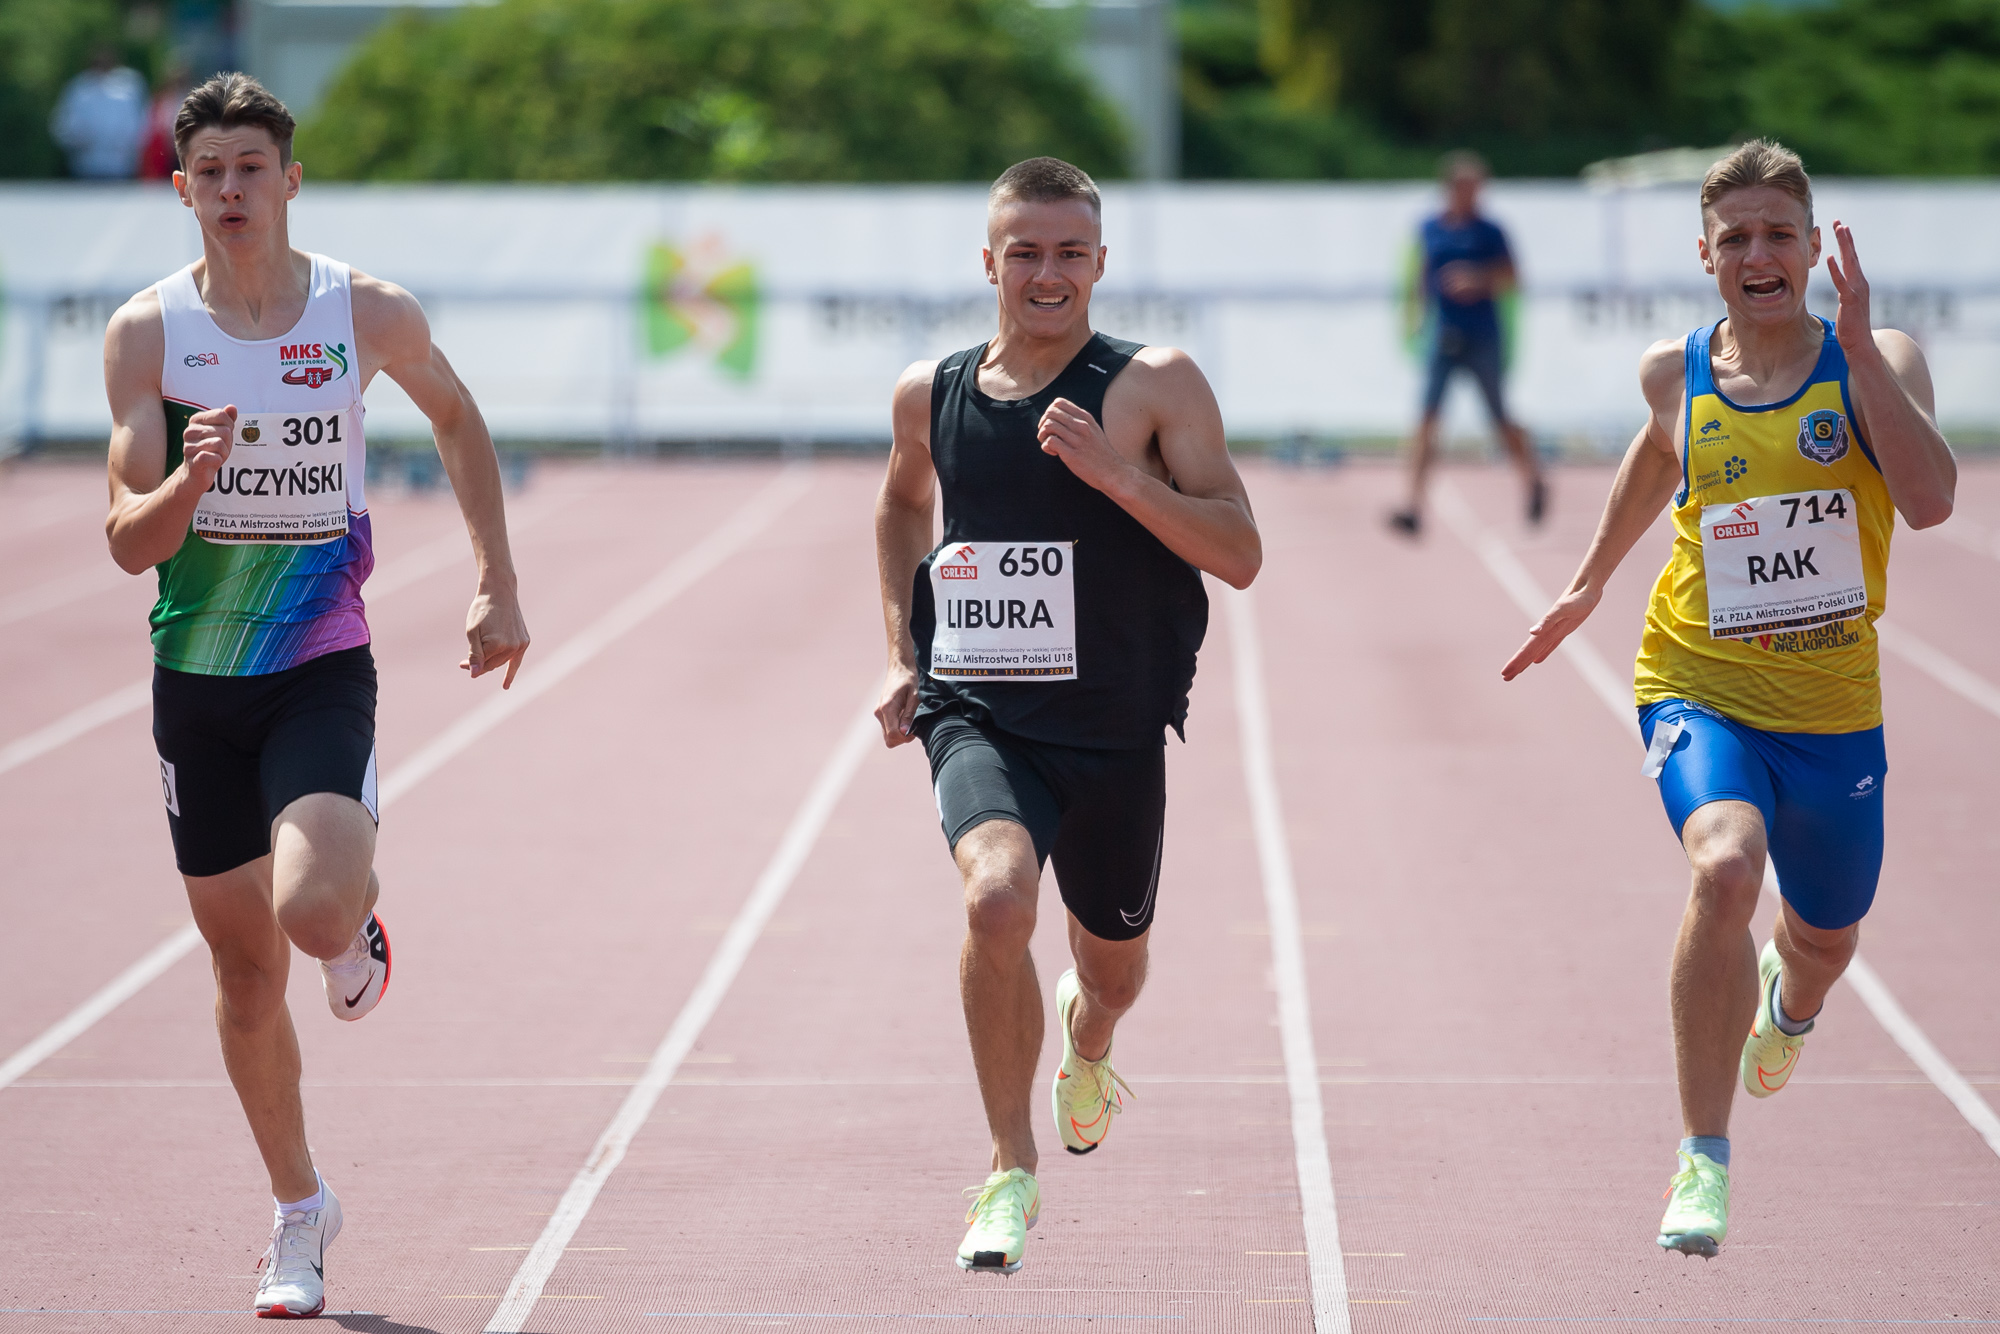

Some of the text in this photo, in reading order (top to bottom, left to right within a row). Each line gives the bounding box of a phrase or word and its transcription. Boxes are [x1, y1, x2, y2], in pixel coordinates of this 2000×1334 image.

[280, 343, 322, 360] MKS
[282, 415, 342, 446] 301
[1818, 424, 1829, 436] S
[206, 461, 343, 496] UCZYŃSKI
[1696, 469, 1720, 483] Powiat
[212, 510, 248, 519] Ogólnopolska
[1780, 492, 1847, 528] 714
[196, 515, 347, 529] 54. PZLA Mistrzostwa Polski U18
[1715, 524, 1757, 538] ORLEN
[942, 567, 975, 578] ORLEN
[999, 547, 1063, 577] 650
[1747, 547, 1820, 585] RAK
[1712, 591, 1865, 625] 54. PZLA Mistrzostwa Polski U18
[1726, 602, 1763, 612] Ogólnopolska
[1764, 599, 1792, 607] Olimpiada
[1827, 590, 1843, 598] lekkiej
[948, 599, 1054, 629] LIBURA
[1774, 631, 1860, 653] WIELKOPOLSKI
[934, 653, 1073, 664] 54. PZLA Mistrzostwa Polski U18
